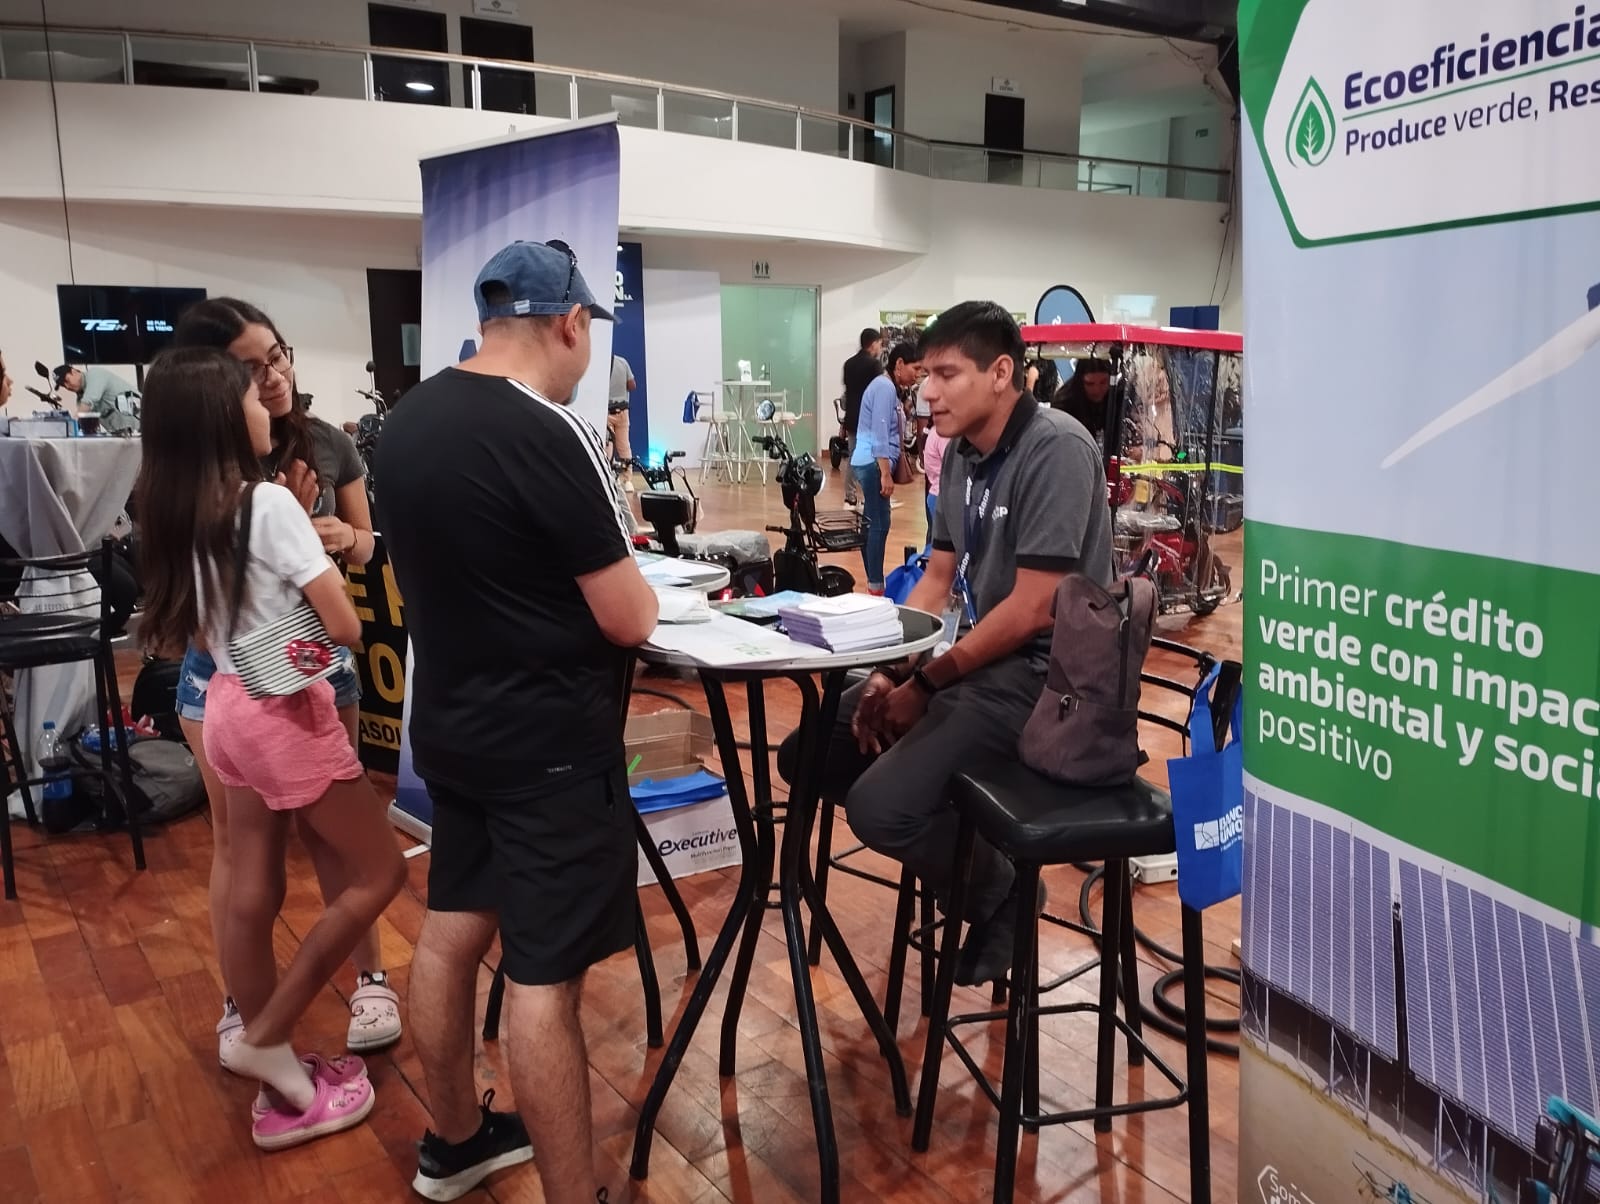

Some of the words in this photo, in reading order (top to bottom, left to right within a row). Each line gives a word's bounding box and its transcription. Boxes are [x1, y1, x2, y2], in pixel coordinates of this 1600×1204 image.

[1346, 115, 1447, 156] Produce
[1453, 92, 1539, 132] verde,
[1261, 559, 1378, 617] Primer
[1385, 590, 1544, 658] crédito
[1258, 615, 1361, 666] verde
[1370, 642, 1438, 690] con
[1452, 652, 1600, 737] impac
[1258, 662, 1447, 749] ambiental
[1456, 721, 1484, 767] y
[1494, 734, 1600, 798] soci
[1258, 708, 1392, 781] positivo
[658, 828, 737, 857] executive
